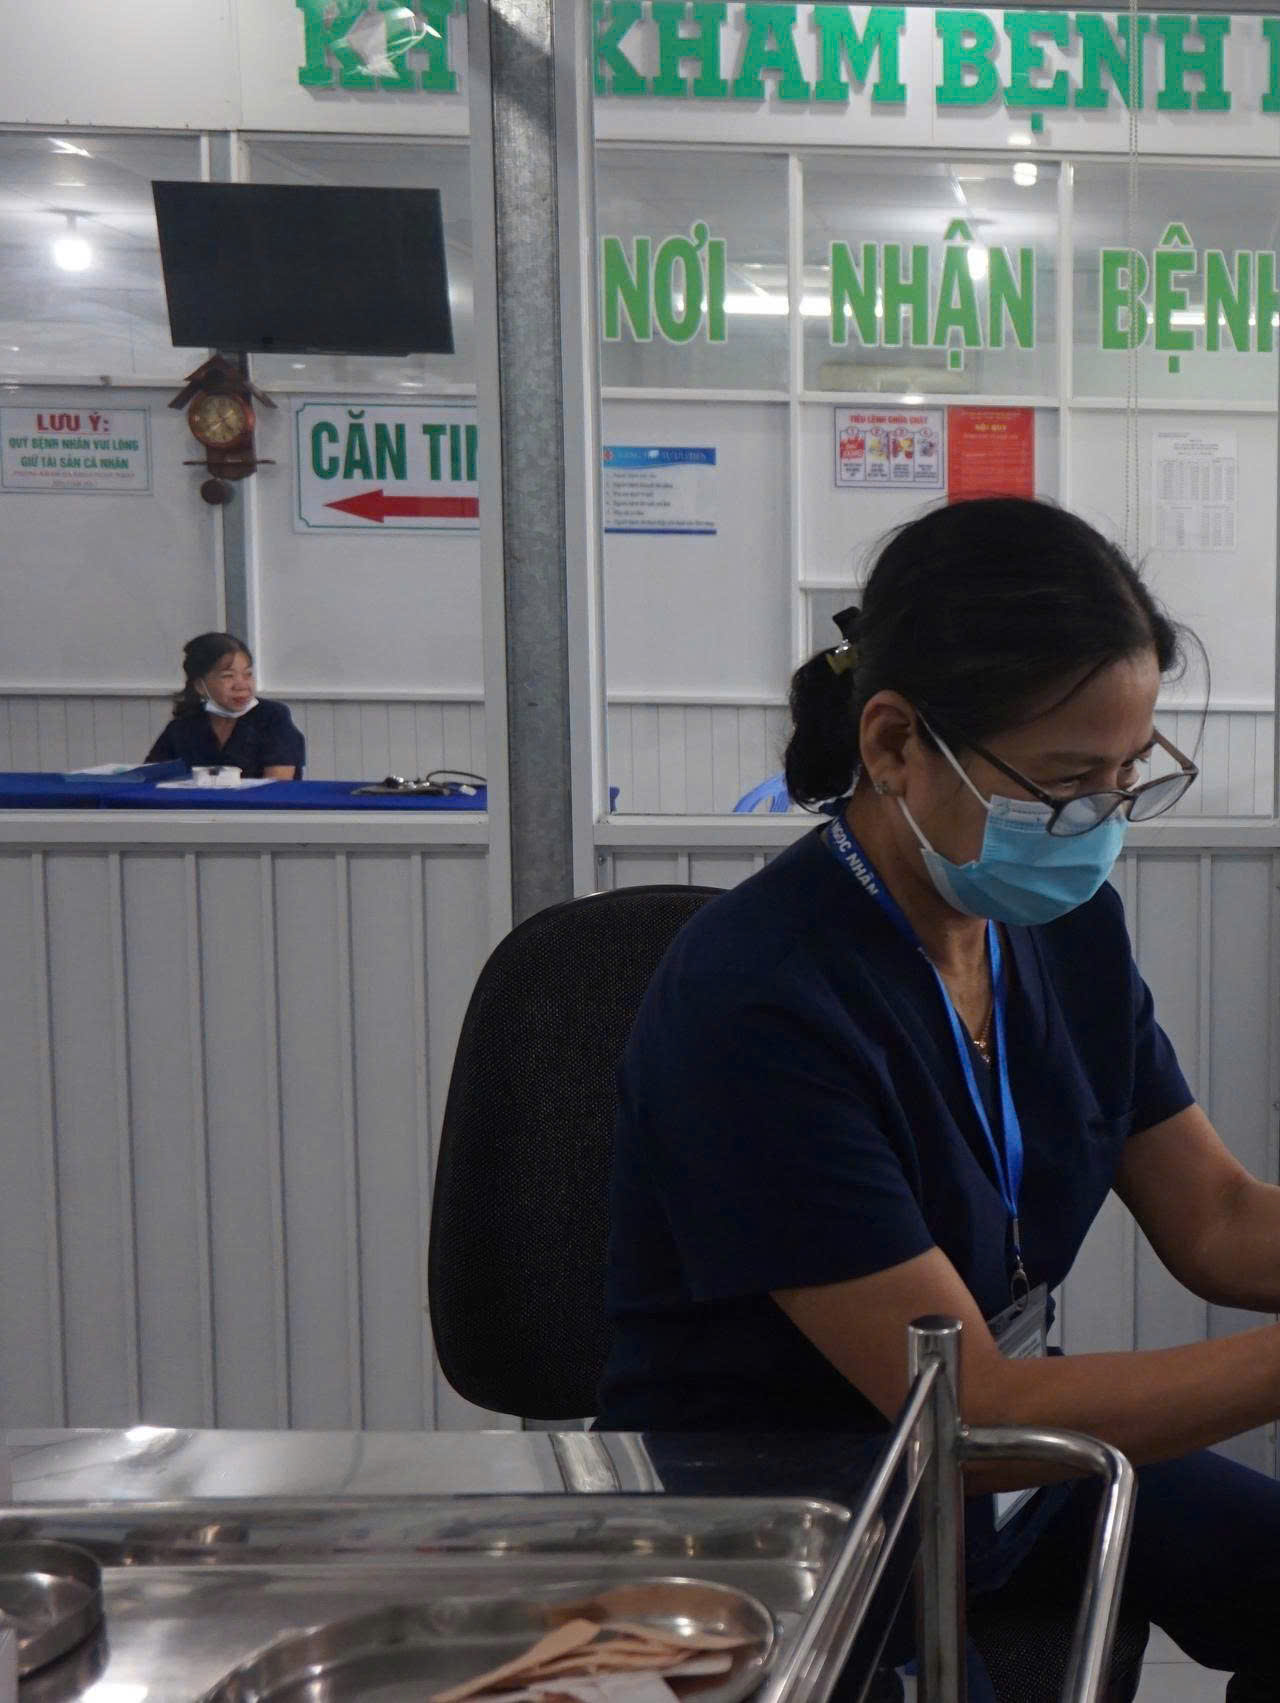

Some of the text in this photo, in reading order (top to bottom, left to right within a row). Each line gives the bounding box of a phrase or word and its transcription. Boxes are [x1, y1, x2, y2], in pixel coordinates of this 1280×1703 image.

[296, 0, 468, 93] KH
[603, 221, 728, 344] NƠI
[830, 218, 1036, 371] NHẬN
[36, 413, 81, 431] LƯU
[311, 409, 408, 481] CĂN
[846, 852, 879, 896] NHÂN
